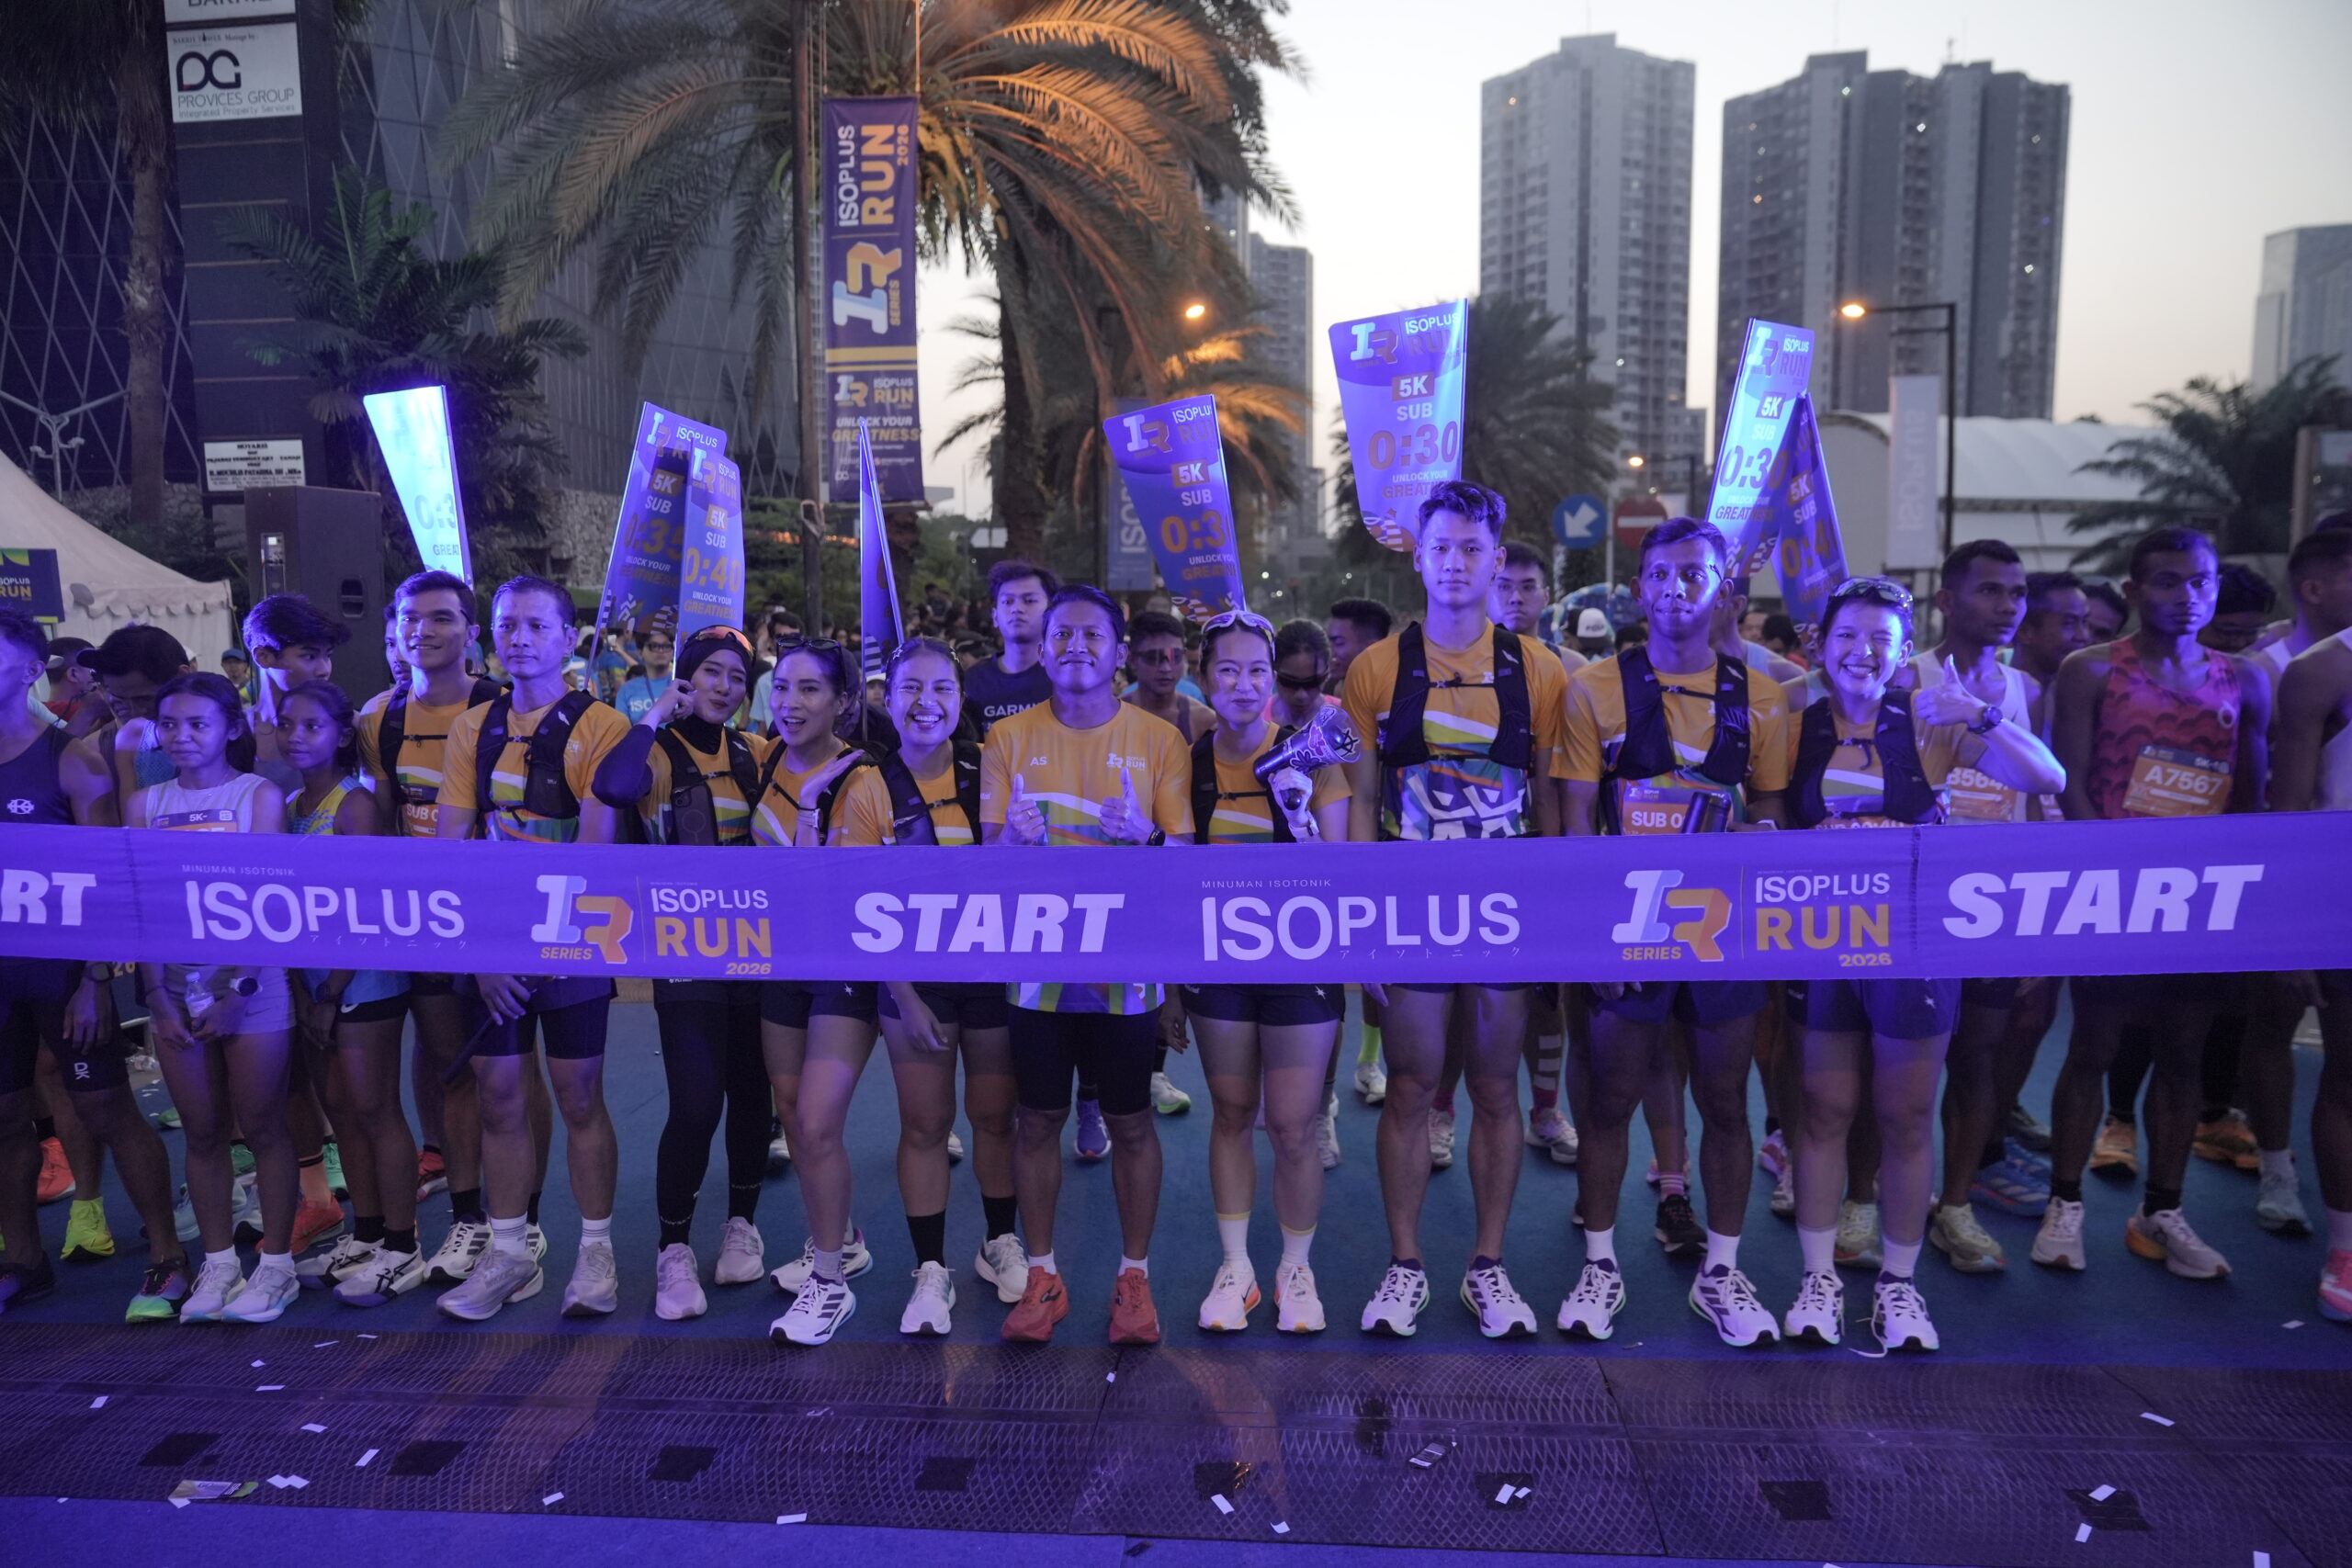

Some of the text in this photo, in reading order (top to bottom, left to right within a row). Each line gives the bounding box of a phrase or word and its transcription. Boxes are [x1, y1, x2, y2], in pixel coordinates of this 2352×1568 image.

[177, 88, 295, 108] PROVICES GROUP
[179, 104, 295, 118] Integrated Property Services
[897, 124, 910, 166] 2026
[838, 124, 860, 227] ISOPLUS
[861, 124, 896, 225] RUN
[888, 279, 901, 326] SERIES
[1404, 312, 1459, 335] ISOPLUS
[1783, 337, 1810, 353] ISOPLUS
[1779, 354, 1807, 377] RUN
[873, 377, 914, 388] ISOPLUS
[1398, 375, 1428, 398] 5K
[874, 388, 914, 403] RUN
[1396, 402, 1433, 422] SUB
[1760, 397, 1781, 417] 5K
[882, 416, 913, 426] YOUR
[676, 425, 718, 448] ISOPLUS
[831, 428, 920, 443] GRETNESS
[1751, 423, 1777, 441] SUB
[1367, 421, 1458, 470] 0:30
[1178, 462, 1205, 484] 5K
[1392, 470, 1429, 483] UNLOCK
[1719, 445, 1789, 490] 0:30
[652, 474, 677, 494] 5K
[719, 476, 737, 501] RUN
[1791, 477, 1811, 502] 5K
[646, 494, 672, 513] SUB
[1181, 489, 1213, 506] SUB
[710, 511, 726, 528] 5K
[1793, 500, 1817, 525] SUB
[706, 531, 727, 548] SUB
[648, 559, 672, 572] YOUR
[684, 547, 741, 592] 0:40
[1189, 554, 1223, 566] UNLOCK
[0, 577, 30, 585] SOPLUS
[692, 591, 717, 603] UNLOCK
[983, 703, 1036, 717] GARM
[1030, 757, 1047, 766] AS
[2143, 765, 2223, 796] A7567
[406, 803, 429, 820] SUB
[1631, 811, 1667, 828] SUB
[182, 864, 295, 876] MINUMAN ISOTONIK
[1202, 878, 1331, 888] MINUMAN ISOTONIK
[1756, 873, 1891, 904] ISOPLUS
[650, 887, 769, 913] ISOPLUS
[1942, 864, 2265, 939] START
[186, 880, 465, 943] ISOPLUS
[851, 892, 1125, 953] START
[1202, 892, 1521, 962] ISOPLUS
[1756, 904, 1890, 952] RUN
[654, 917, 772, 958] RUN
[540, 947, 593, 960] SERIES
[1622, 946, 1682, 961] SERIES
[1839, 953, 1893, 967] 2026
[724, 962, 773, 976] 2026
